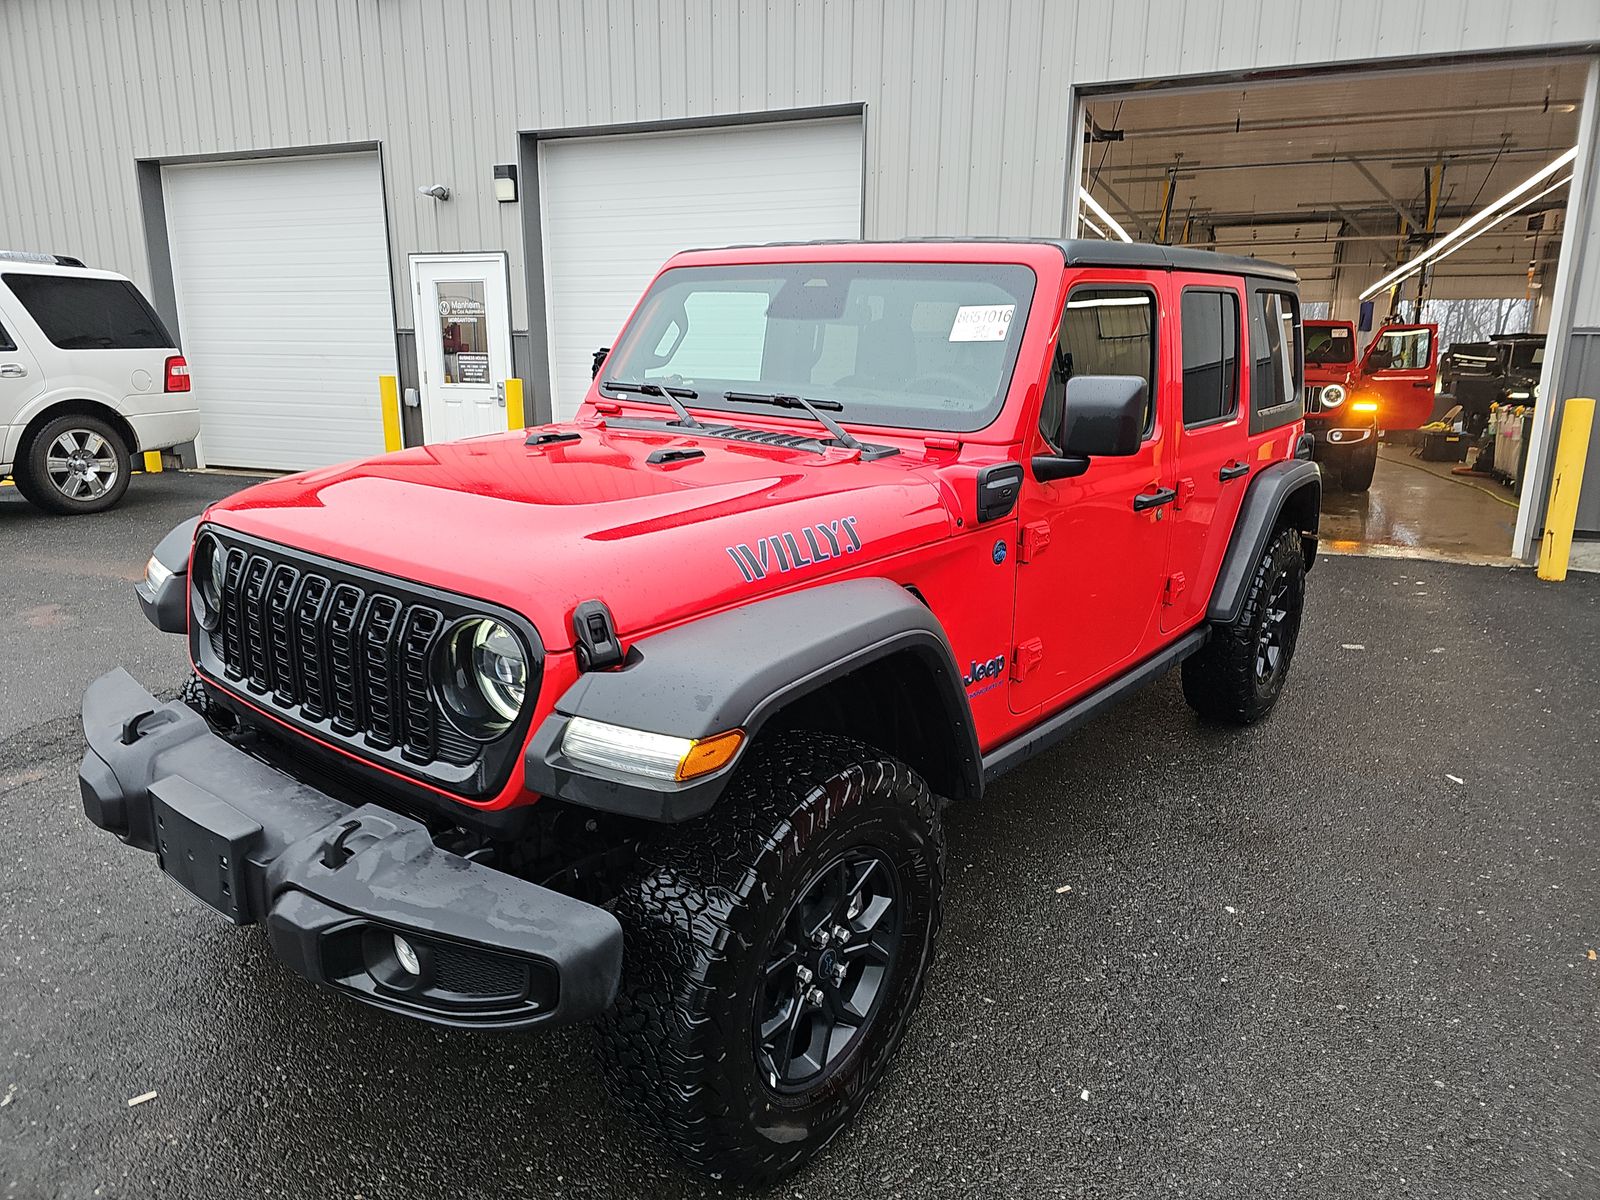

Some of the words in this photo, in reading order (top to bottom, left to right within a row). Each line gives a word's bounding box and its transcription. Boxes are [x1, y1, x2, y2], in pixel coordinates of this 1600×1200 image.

[451, 300, 480, 309] Manheim
[725, 515, 862, 583] WILLYS
[963, 654, 1006, 687] Jeep
